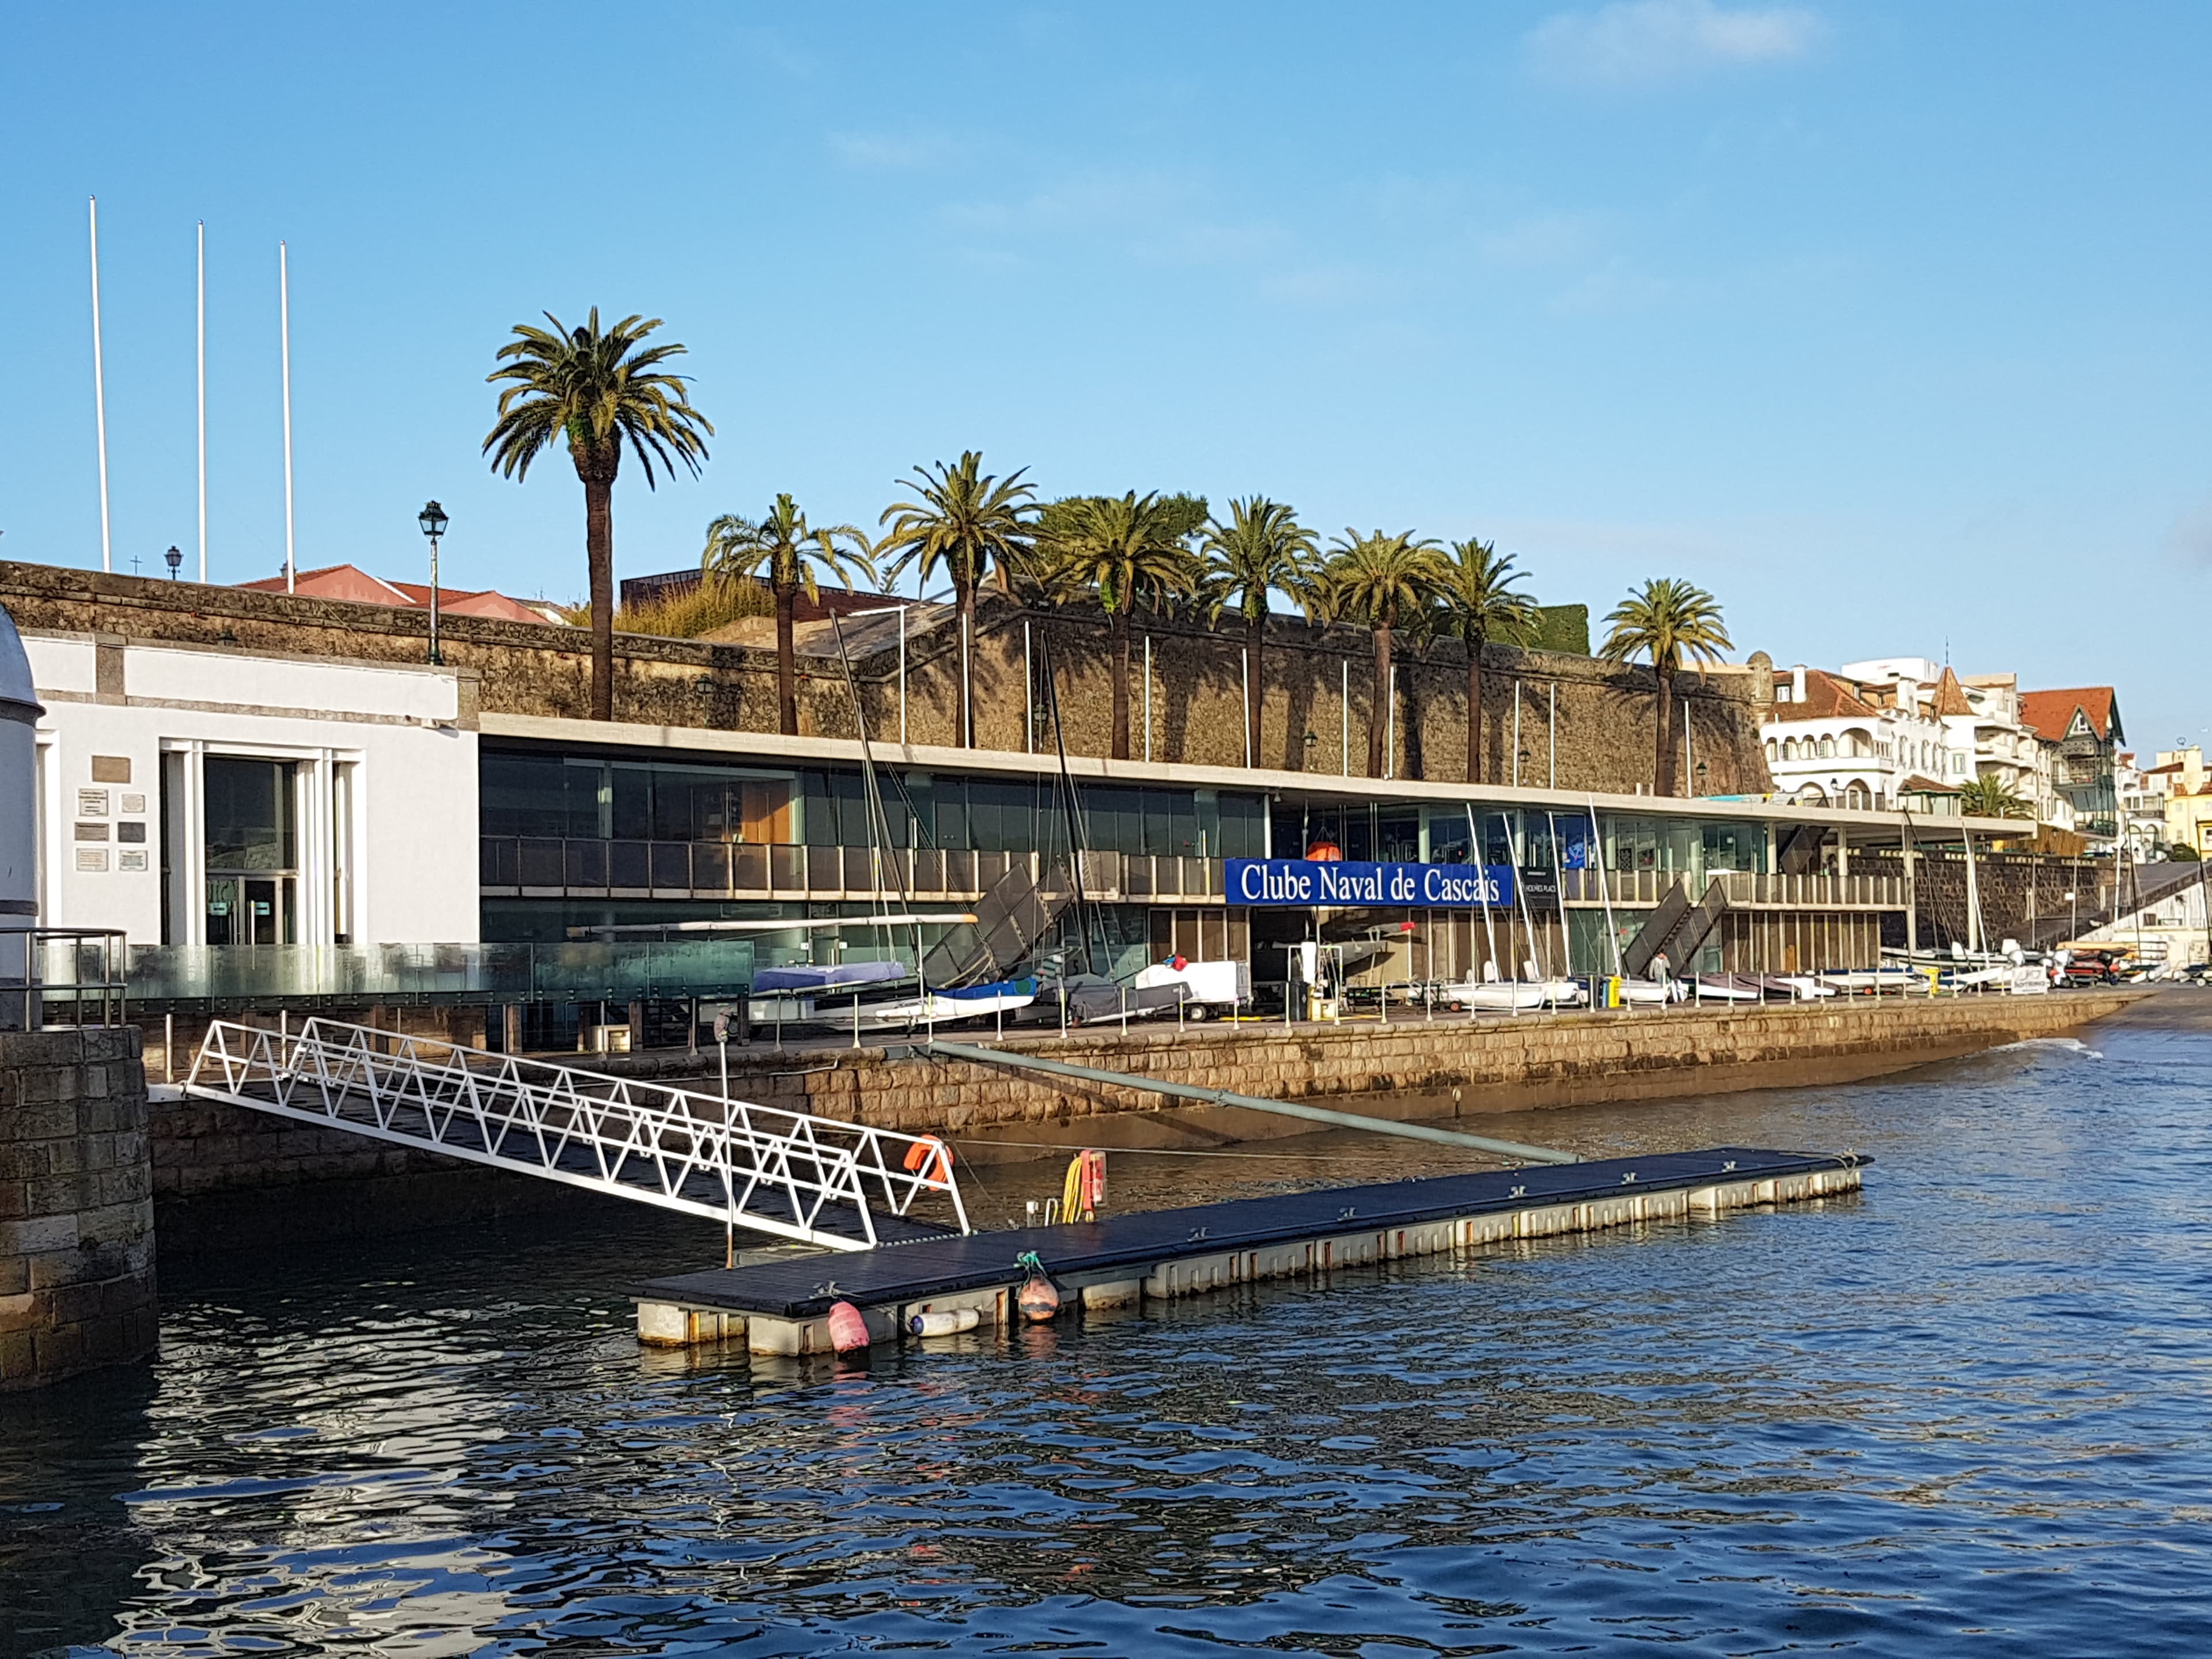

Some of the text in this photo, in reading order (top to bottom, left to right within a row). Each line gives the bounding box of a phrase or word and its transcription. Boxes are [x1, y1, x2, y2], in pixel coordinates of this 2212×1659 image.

[1241, 865, 1499, 902] Clube Naval de Cascais
